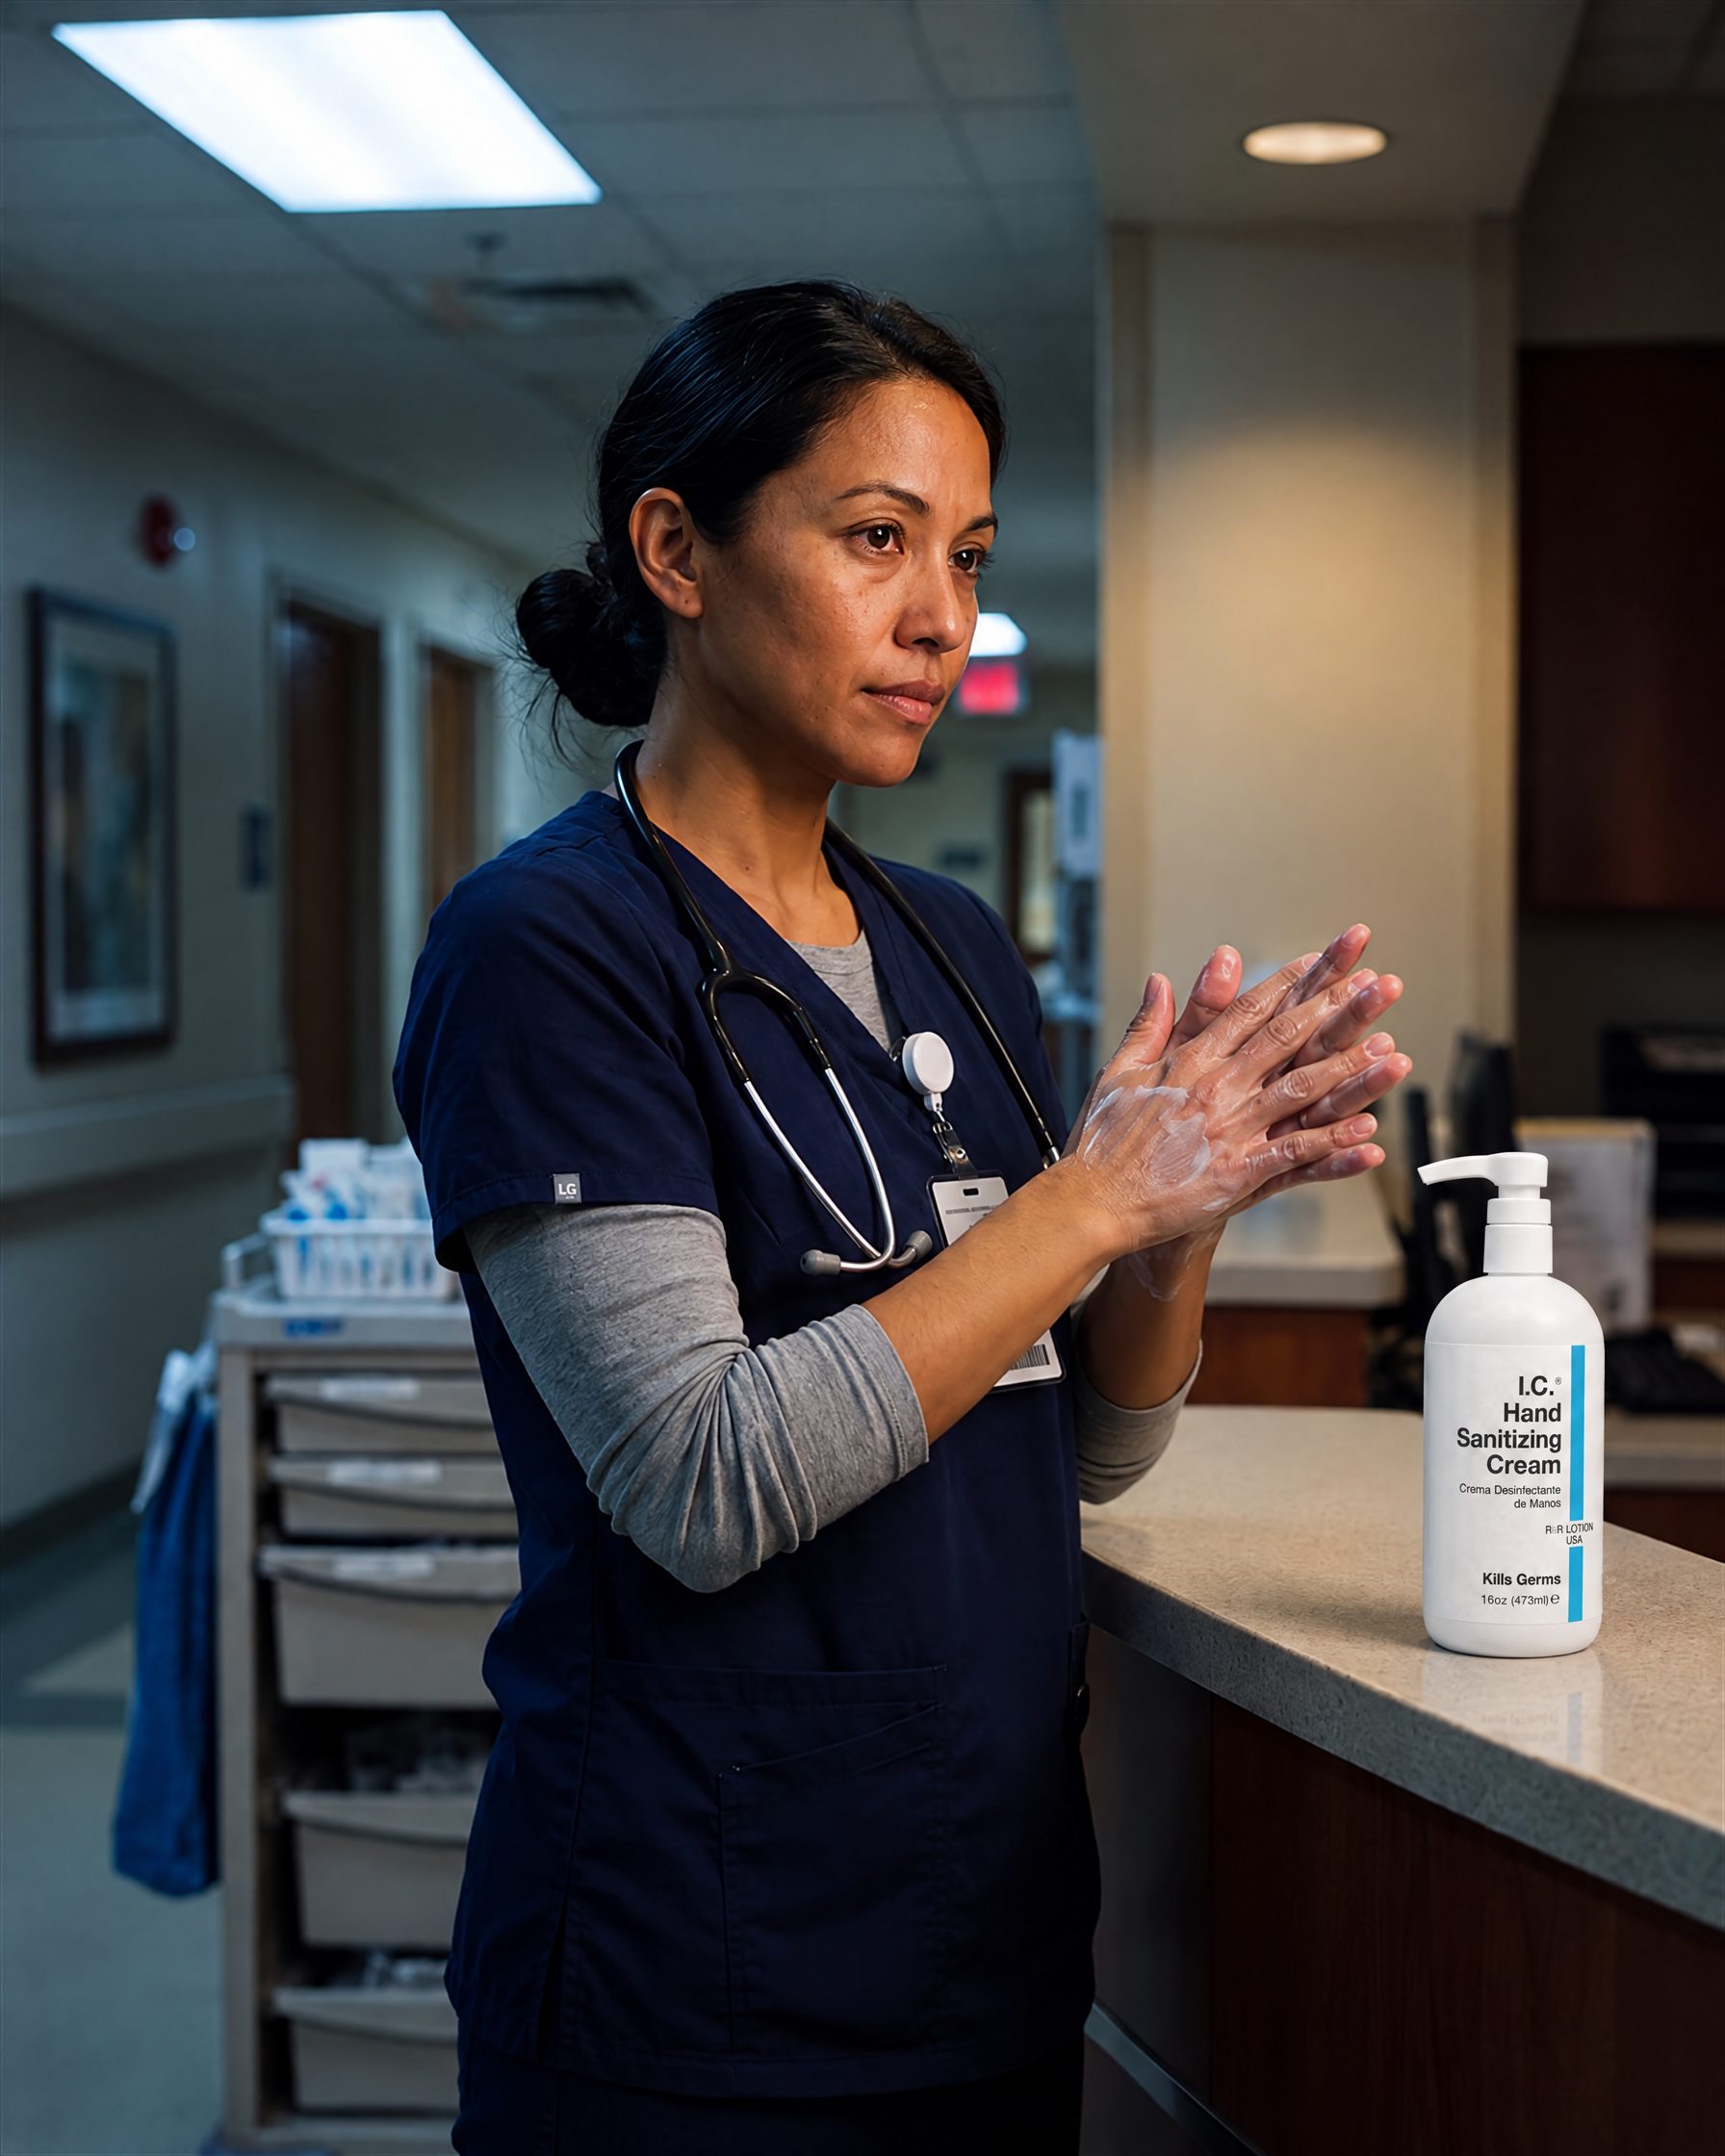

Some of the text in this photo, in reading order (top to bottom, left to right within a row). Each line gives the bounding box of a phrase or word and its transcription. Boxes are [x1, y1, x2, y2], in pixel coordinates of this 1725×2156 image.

[558, 1183, 578, 1195] LG
[1503, 1402, 1561, 1423] Hand
[1456, 1427, 1561, 1453] Sanitizing
[1486, 1454, 1561, 1475] Cream
[1459, 1483, 1561, 1496] Crema Desinfectante
[1513, 1499, 1561, 1509] de Manos
[1565, 1523, 1594, 1534] LOTION
[1565, 1535, 1583, 1546] USA
[1482, 1573, 1561, 1585] Kills Germs
[1481, 1594, 1507, 1605] 16oz
[1510, 1595, 1549, 1607] (473ml)
